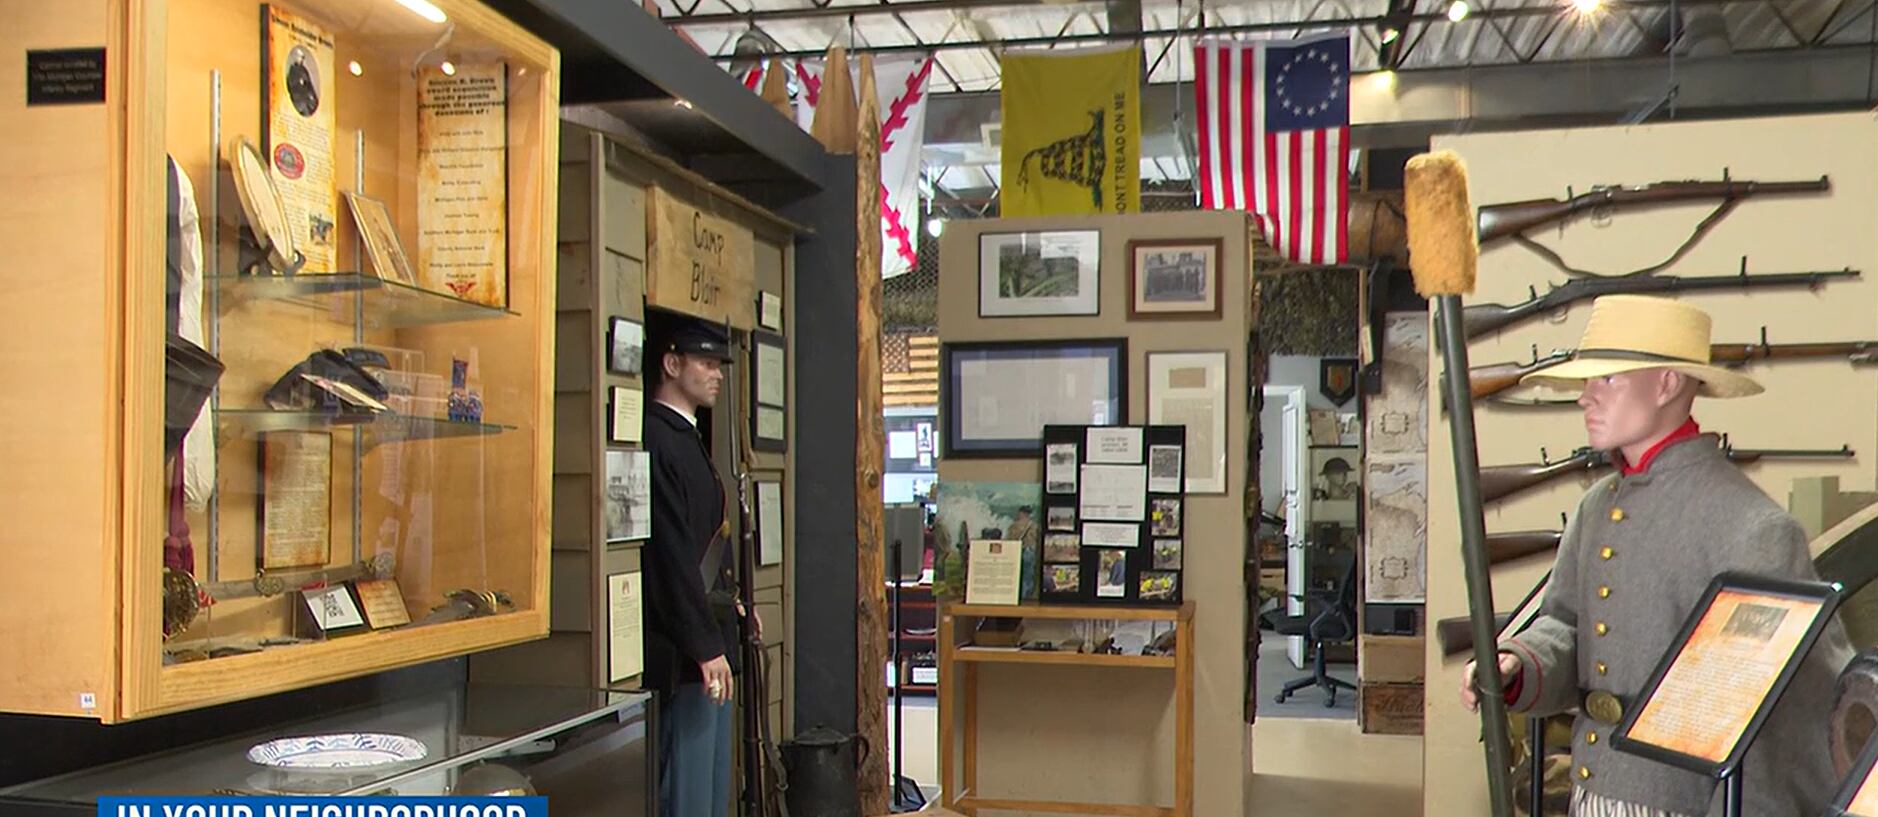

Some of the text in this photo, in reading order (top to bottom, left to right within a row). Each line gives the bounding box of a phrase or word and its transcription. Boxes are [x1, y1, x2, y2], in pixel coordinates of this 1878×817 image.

[1114, 91, 1127, 214] ONT TREAD ON ME
[693, 211, 725, 267] Camp
[690, 260, 720, 307] Blair
